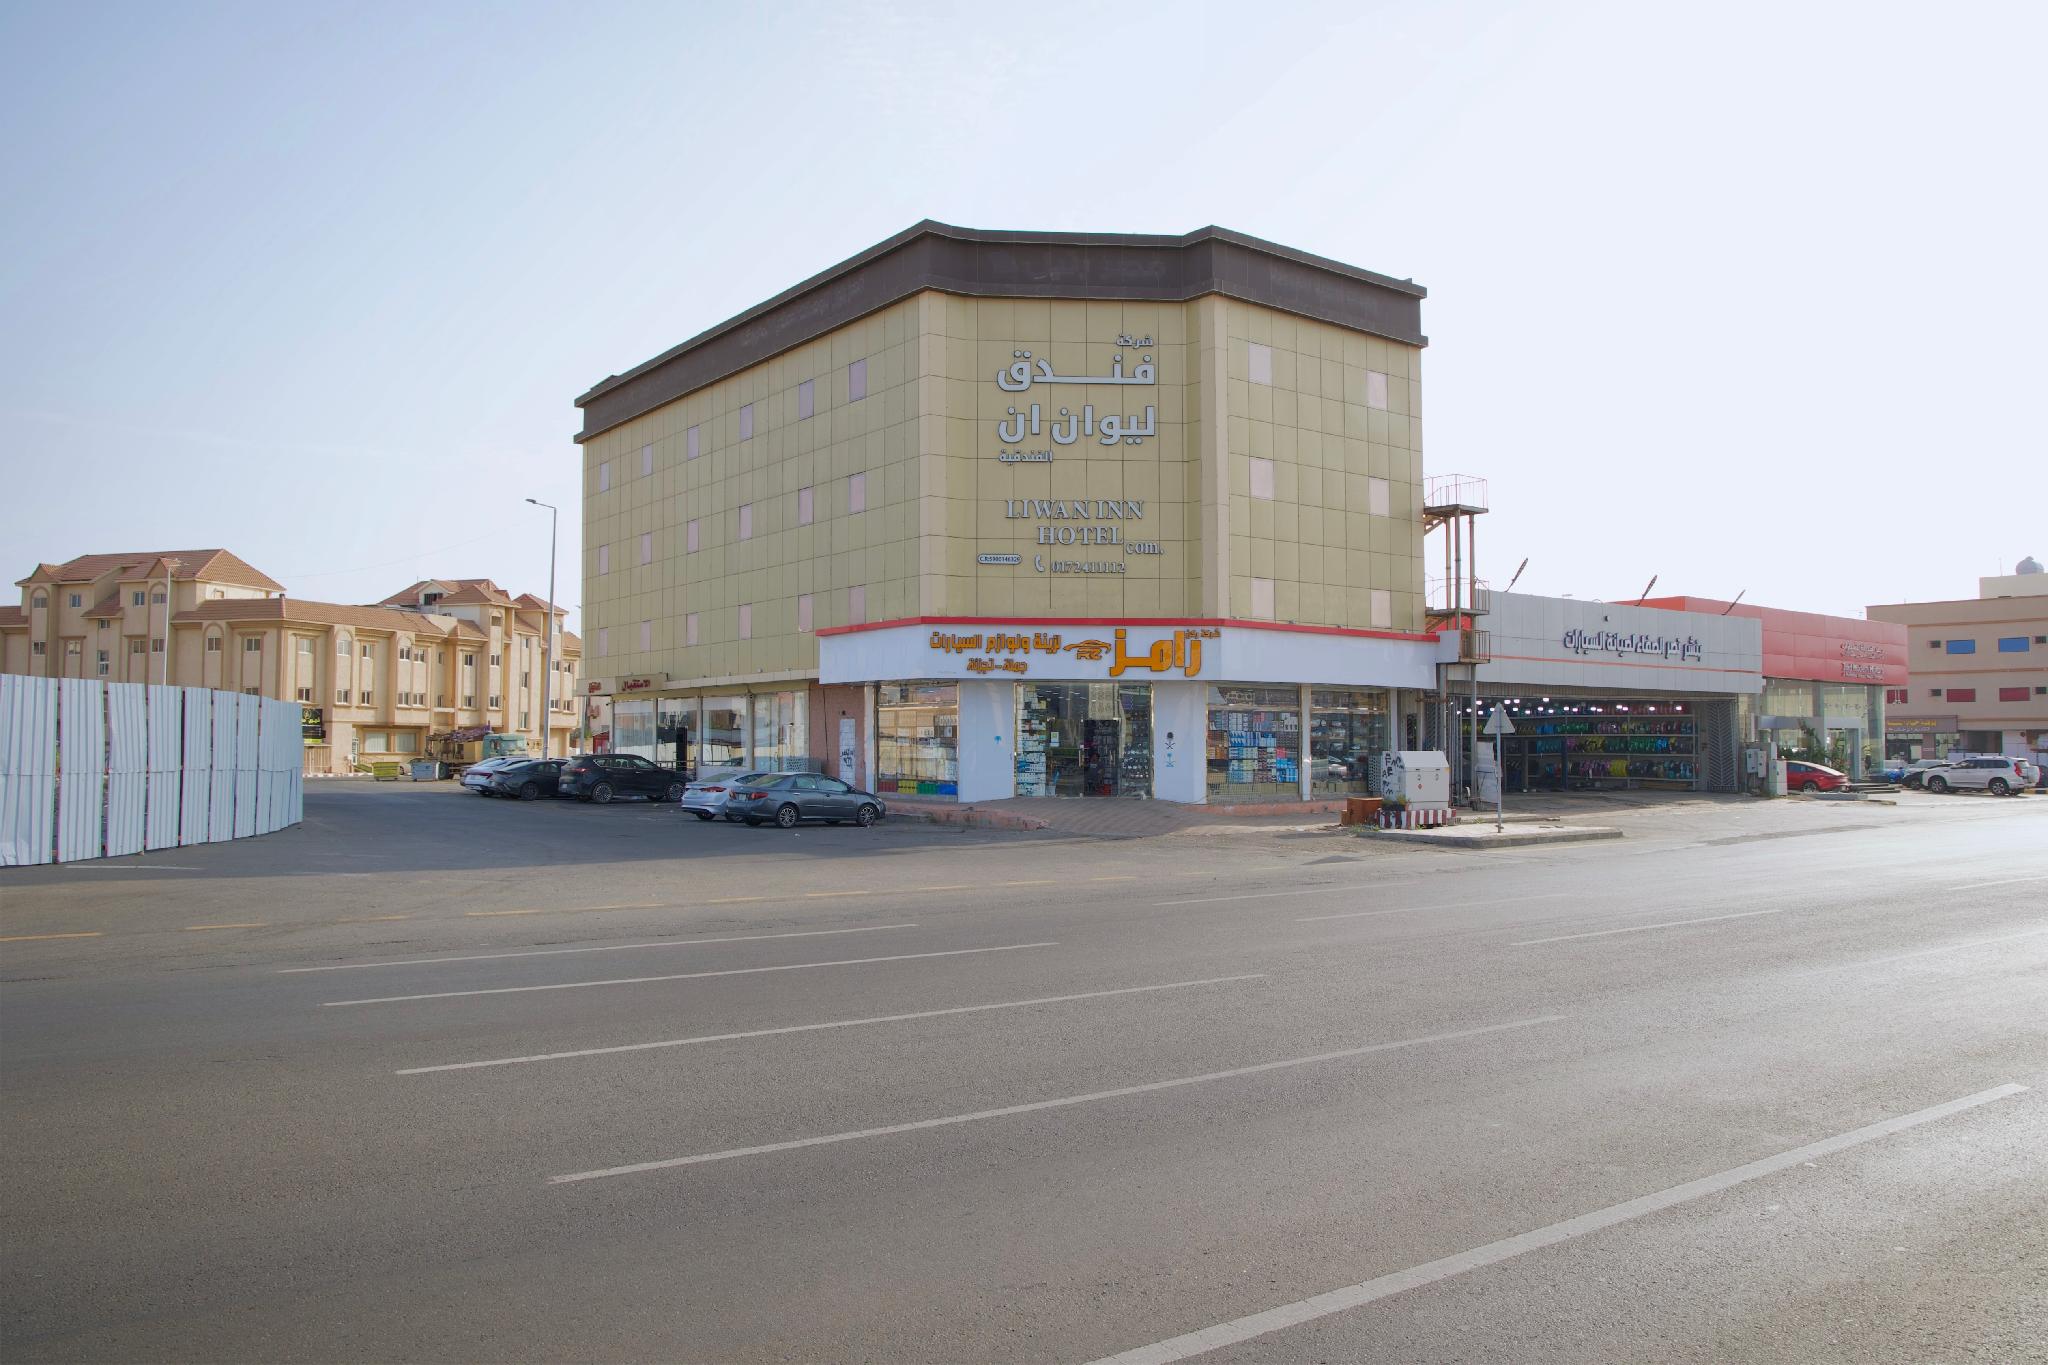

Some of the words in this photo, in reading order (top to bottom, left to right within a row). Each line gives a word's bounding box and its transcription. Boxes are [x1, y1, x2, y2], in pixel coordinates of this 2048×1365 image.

[1115, 333, 1154, 350] شركة
[996, 350, 1156, 392] فندق
[1051, 404, 1156, 446] ليوان
[1005, 499, 1090, 519] LIWAN
[1096, 499, 1144, 519] INN
[1036, 526, 1124, 546] HOTEL
[929, 631, 983, 654] السيارات
[985, 633, 1031, 654] ولوازم
[1109, 628, 1202, 677] رامز
[1563, 628, 1605, 655] السيارات
